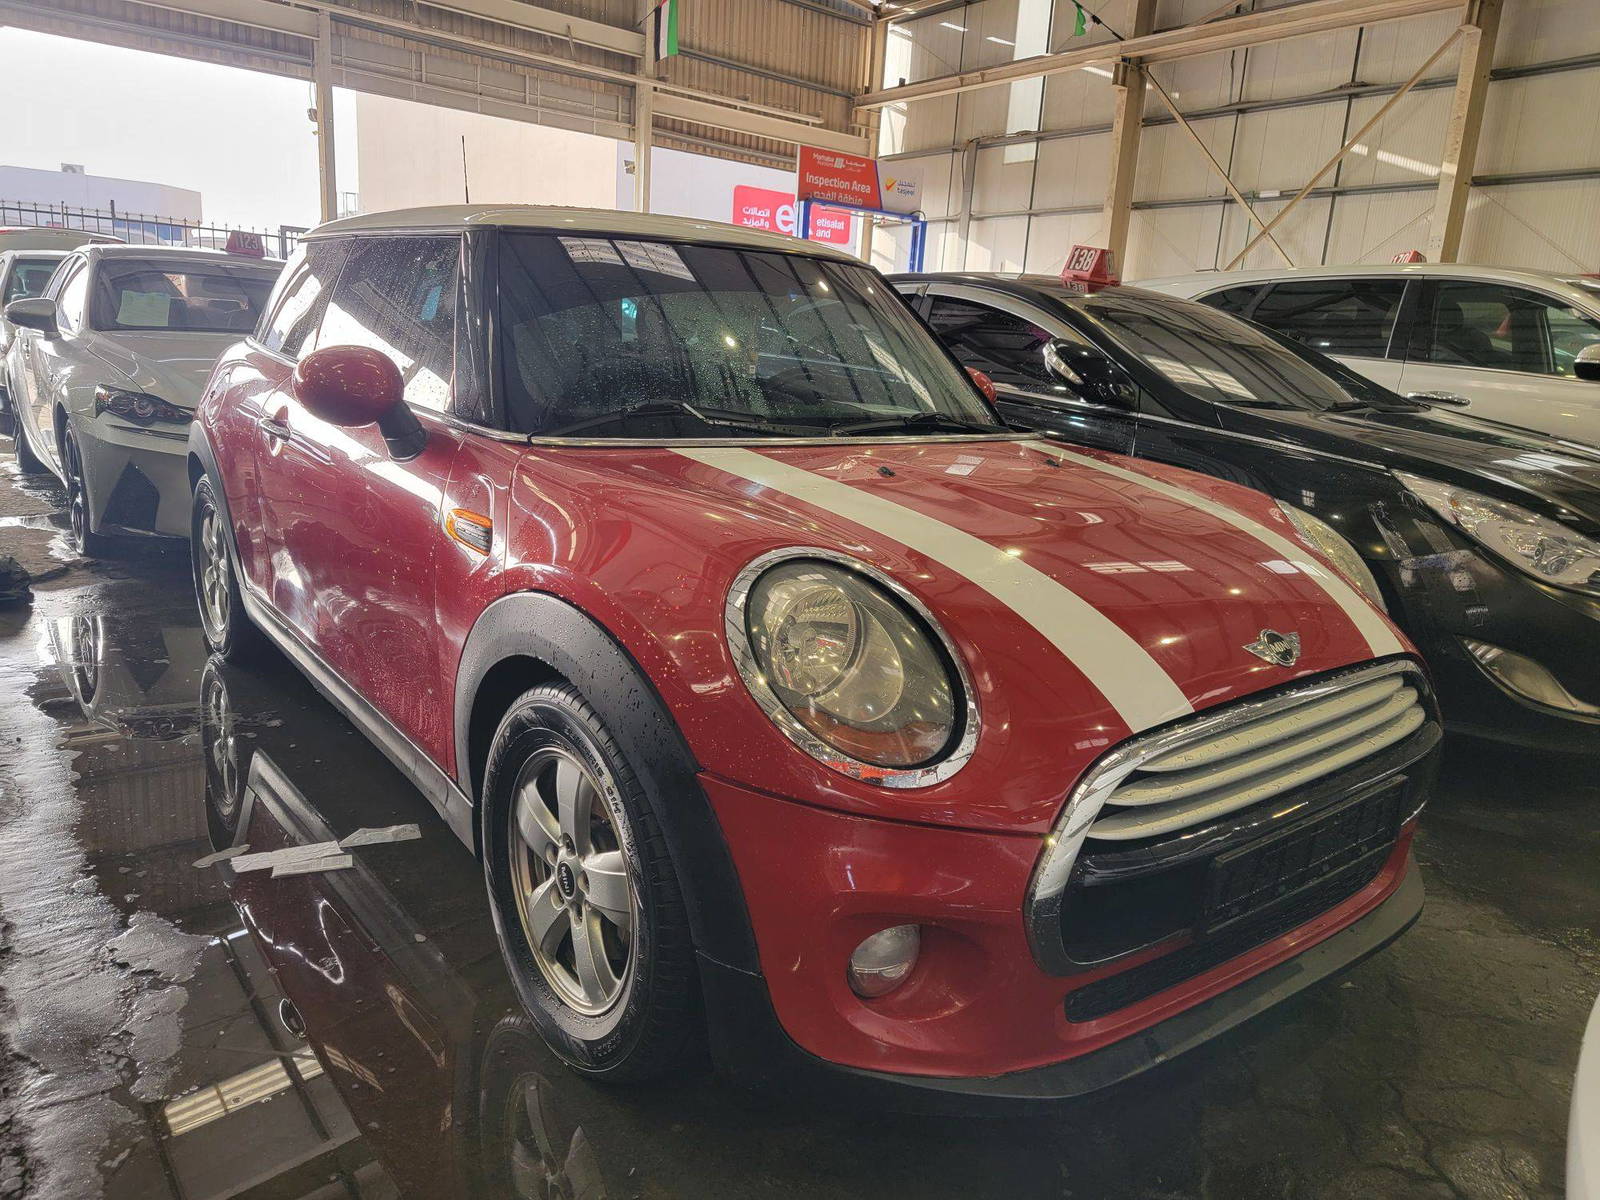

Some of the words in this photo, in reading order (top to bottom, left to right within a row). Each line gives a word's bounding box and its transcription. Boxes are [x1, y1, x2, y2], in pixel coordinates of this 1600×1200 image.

[806, 171, 850, 190] Inspection
[851, 180, 871, 193] Area
[742, 206, 770, 217] اتصالات
[816, 218, 845, 230] etisalat
[816, 228, 831, 238] and
[1069, 248, 1096, 271] 138
[560, 866, 570, 893] MINI
